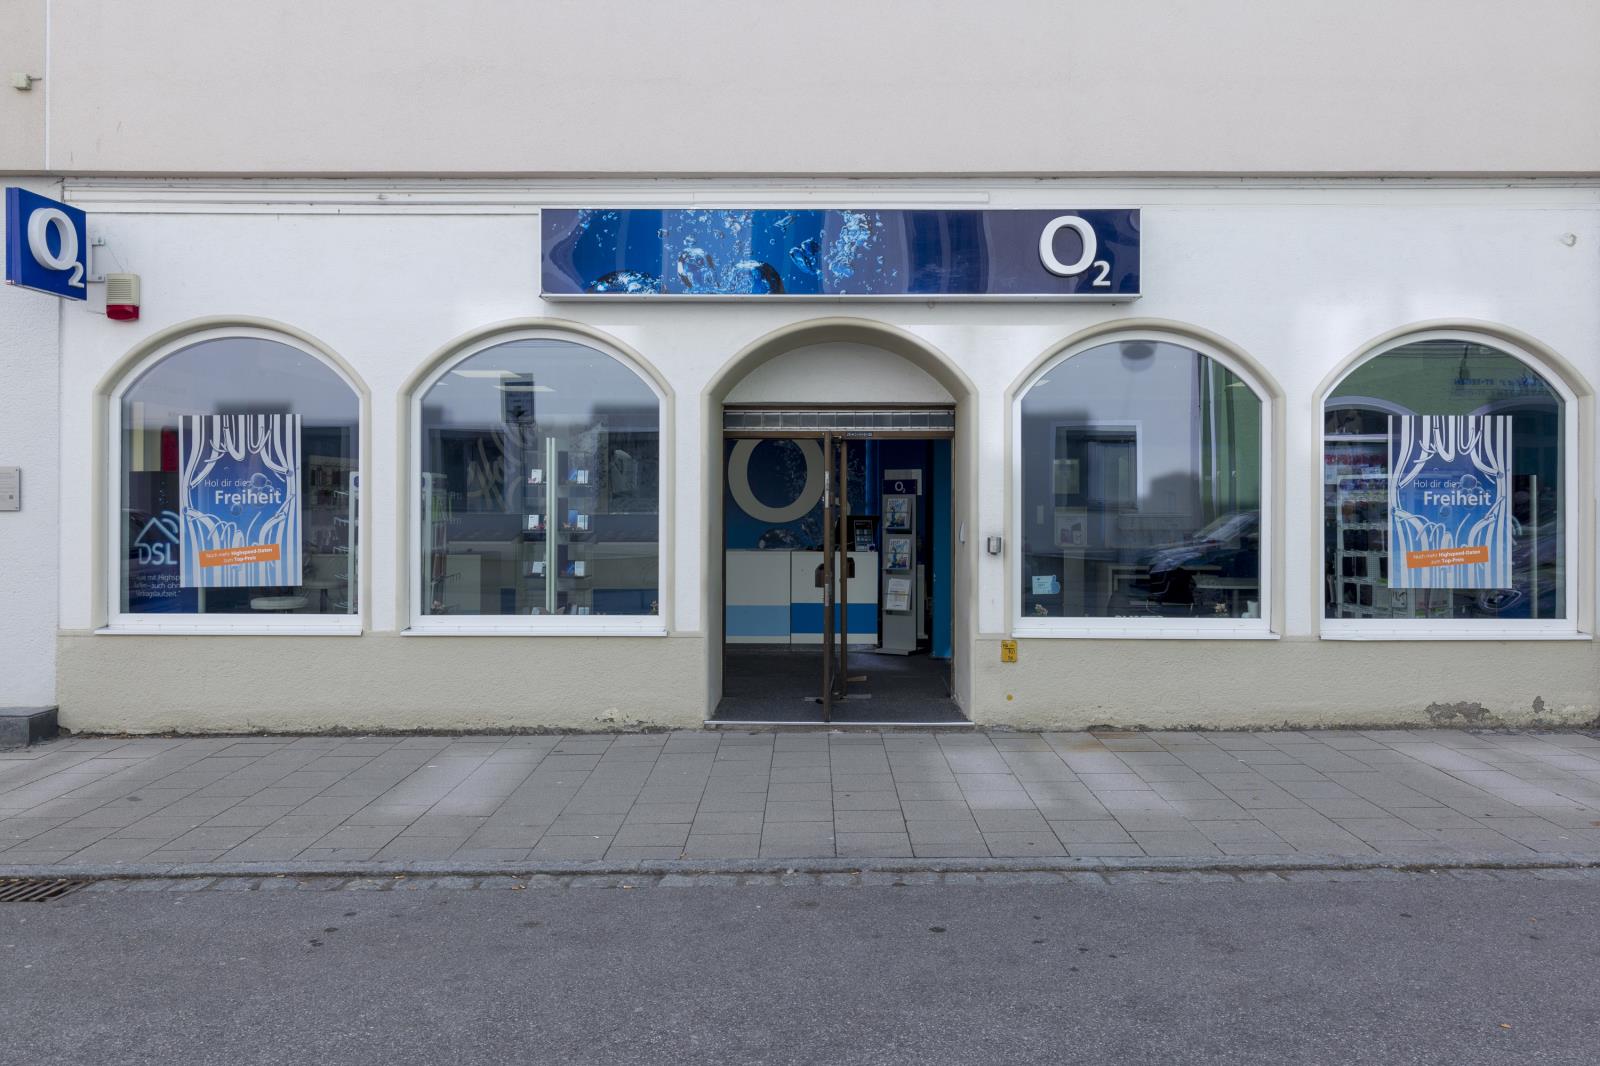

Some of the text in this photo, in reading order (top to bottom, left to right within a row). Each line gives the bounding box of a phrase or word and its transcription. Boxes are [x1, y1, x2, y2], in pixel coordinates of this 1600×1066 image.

[27, 207, 85, 288] O2
[1038, 215, 1111, 287] O2
[204, 479, 247, 488] Hol dir die
[1413, 479, 1457, 488] Hol dir die
[214, 489, 282, 505] Freiheit
[1423, 490, 1491, 506] Freiheit
[137, 542, 178, 565] DSL
